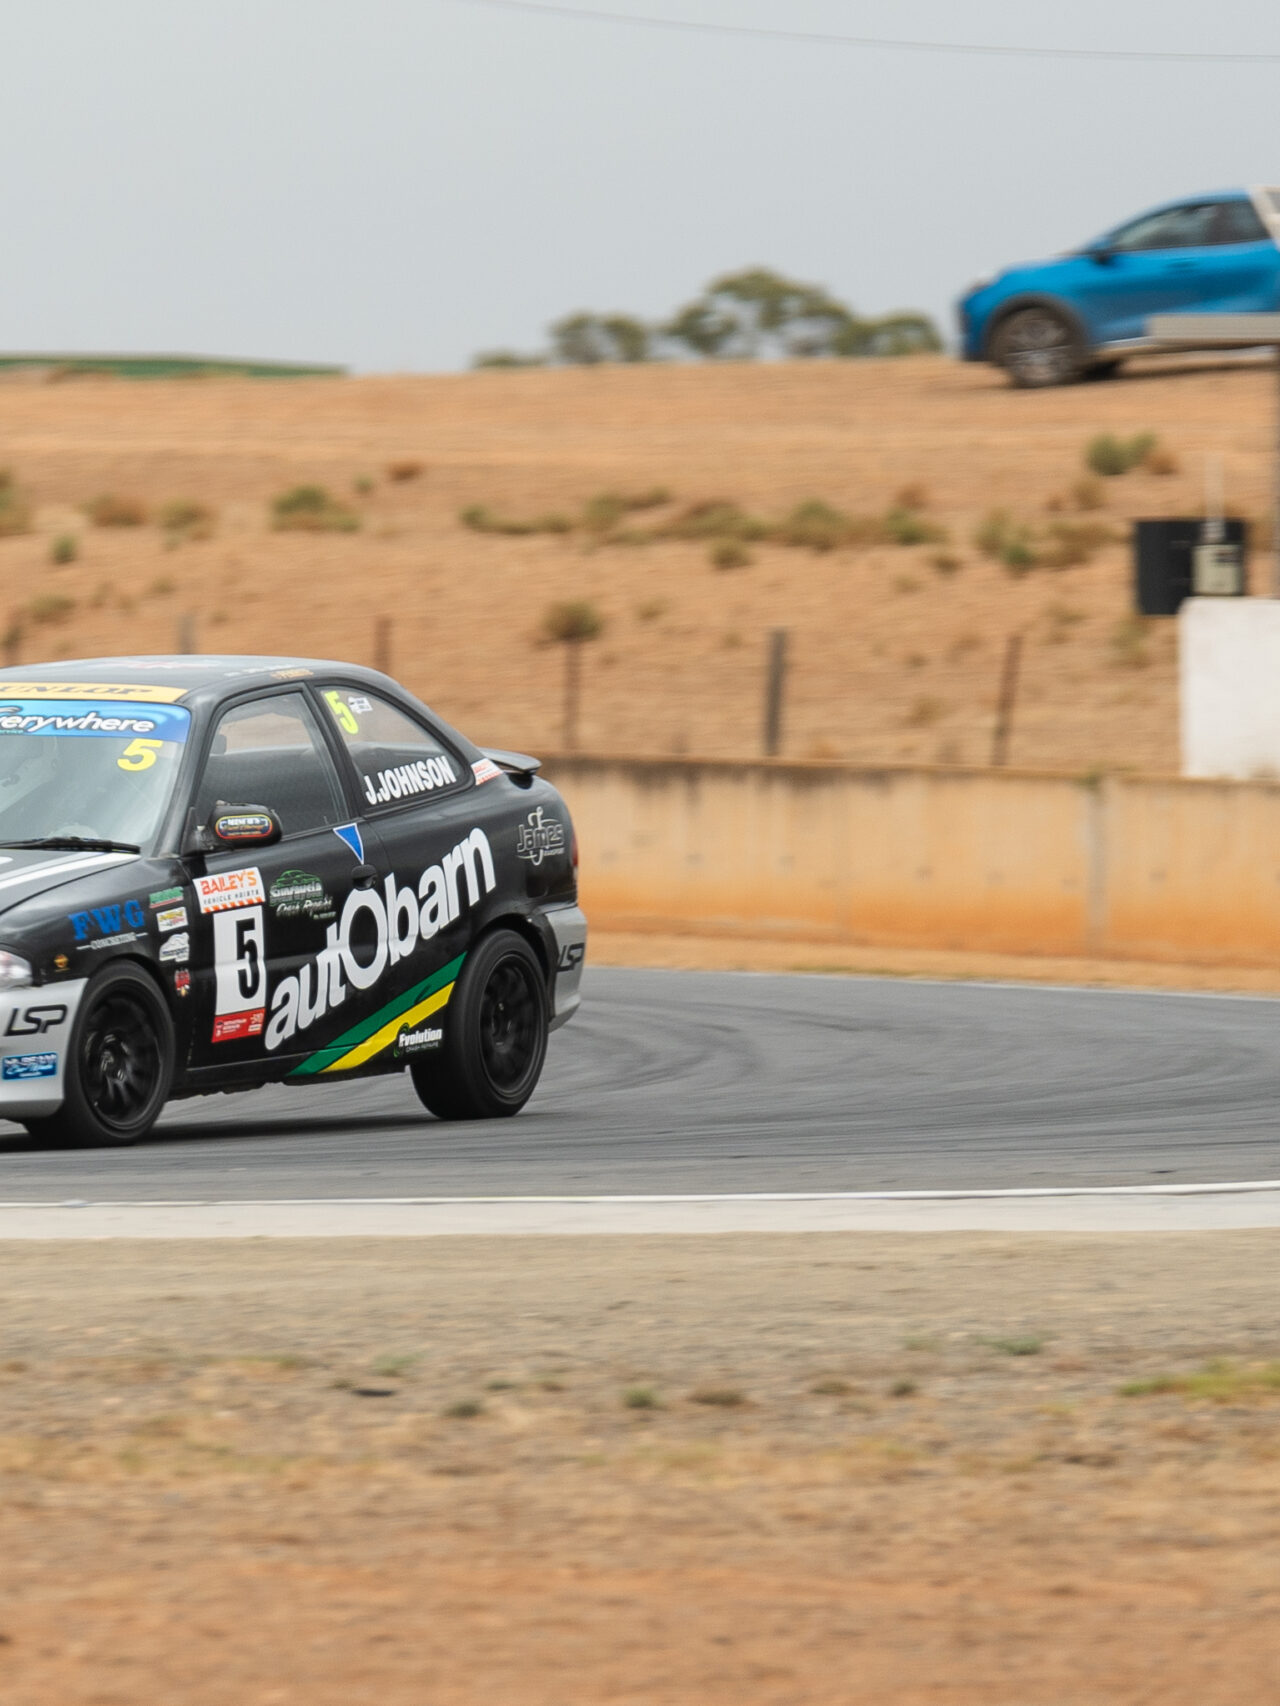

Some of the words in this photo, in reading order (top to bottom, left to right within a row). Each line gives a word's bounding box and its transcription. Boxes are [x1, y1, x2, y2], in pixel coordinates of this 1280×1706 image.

[324, 690, 359, 735] 5
[117, 738, 163, 771] 5
[363, 754, 457, 805] J.JOHNSON
[200, 870, 257, 895] BAILEY'S
[67, 899, 145, 940] FWG
[235, 917, 261, 1000] 5
[3, 1004, 68, 1037] LSP
